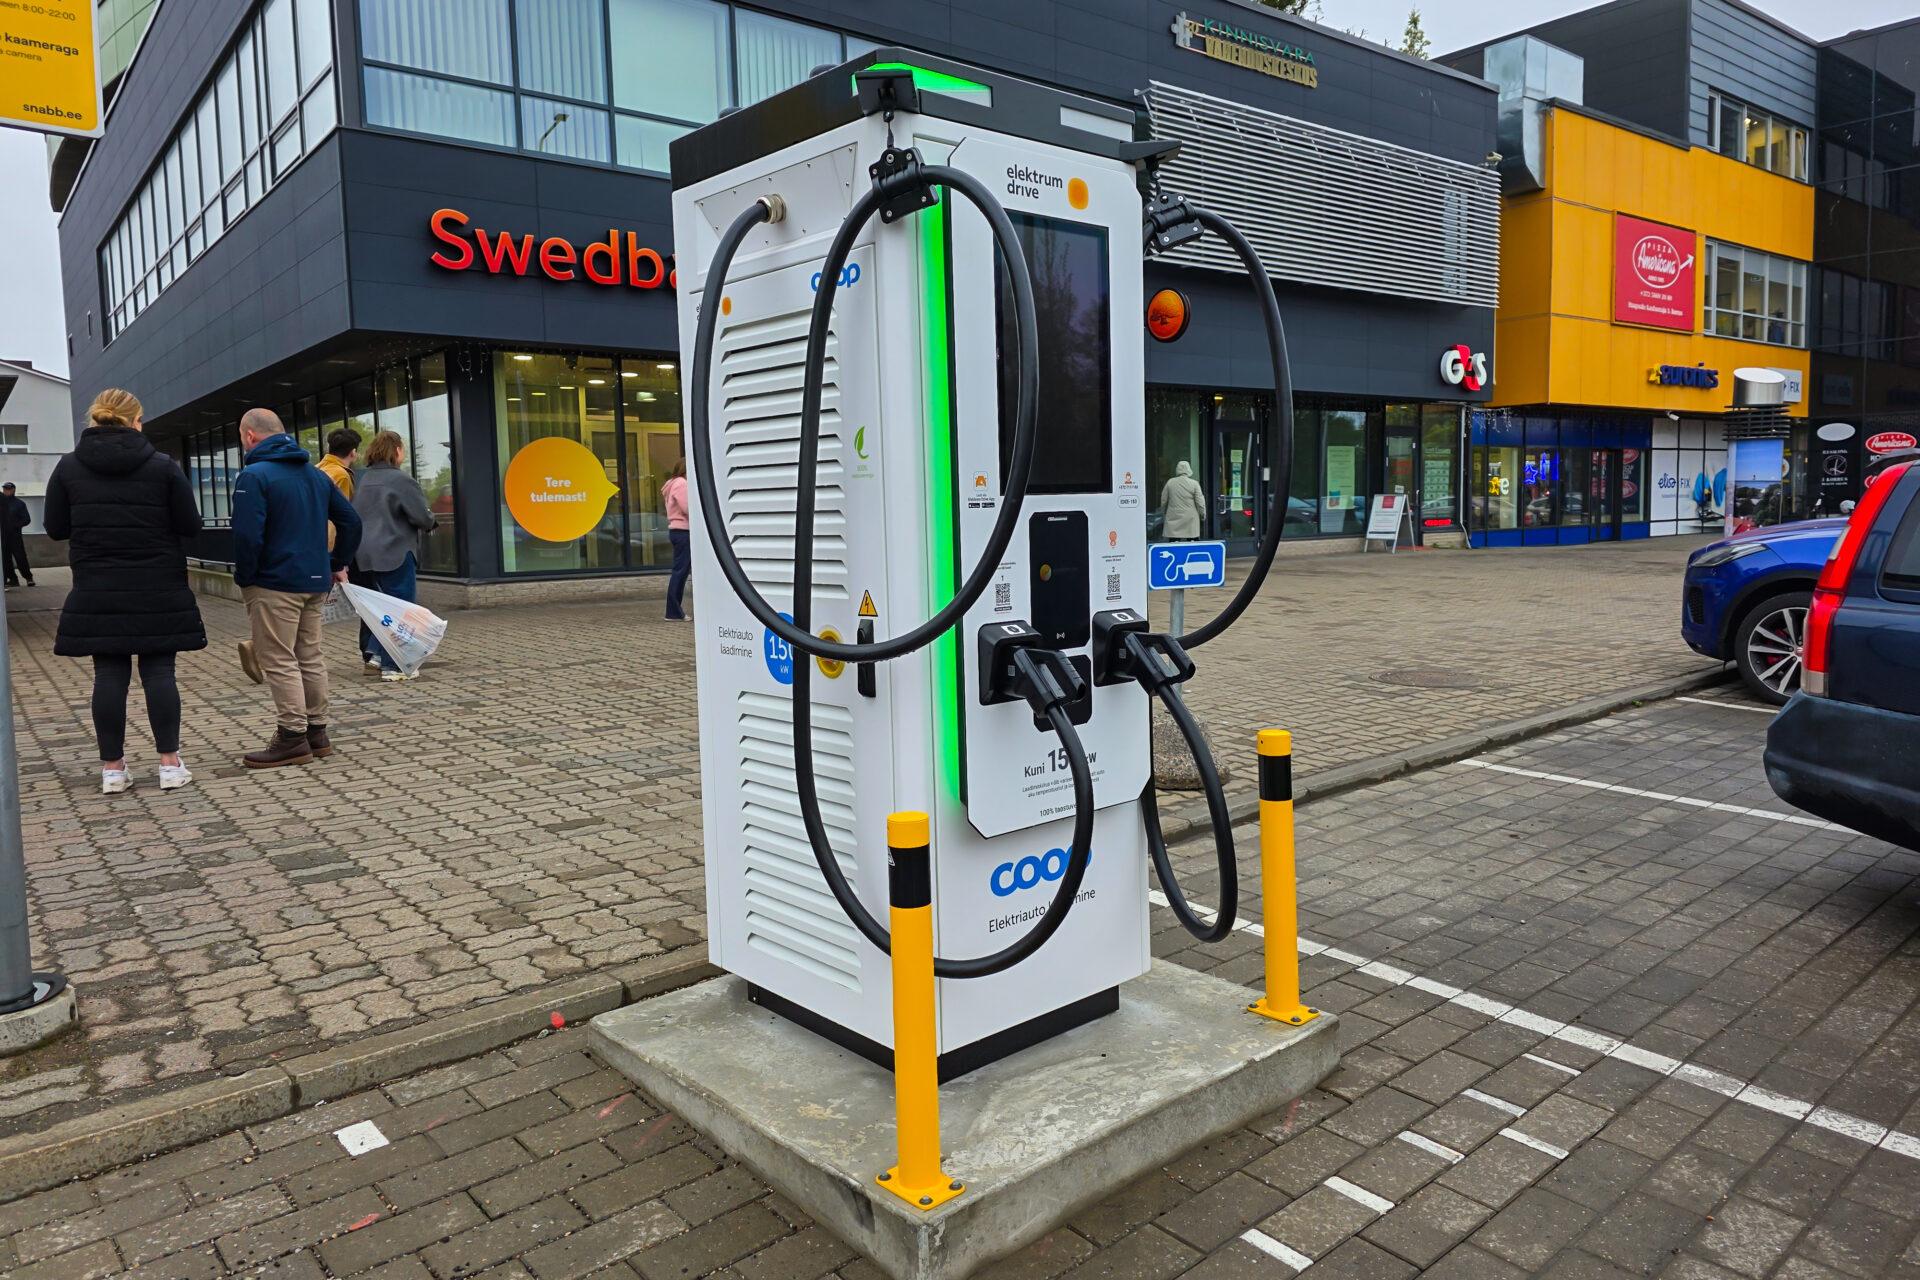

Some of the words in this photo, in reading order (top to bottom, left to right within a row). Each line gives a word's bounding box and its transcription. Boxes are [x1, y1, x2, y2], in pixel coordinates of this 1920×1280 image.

[22, 3, 76, 21] 8:00-22:00
[4, 32, 79, 56] kaameraga
[1204, 18, 1315, 65] KINNISVARA
[5, 49, 42, 62] camera
[23, 104, 82, 120] snabb.ee
[1006, 164, 1063, 188] elektrum
[1007, 179, 1039, 199] drive
[430, 208, 677, 289] Swedb
[810, 262, 861, 291] cop
[1440, 345, 1487, 391] G4S
[1660, 362, 1719, 389] euronics
[1789, 381, 1800, 393] FIX
[1871, 436, 1912, 448] Americana
[545, 477, 571, 488] Tere
[1680, 478, 1690, 488] FIX
[530, 491, 587, 503] tulemast!
[718, 626, 753, 641] Elektriauto
[720, 643, 753, 658] laadimine
[780, 664, 789, 674] kW
[1024, 763, 1045, 777] Kuni
[1048, 748, 1070, 772] 15
[1040, 808, 1054, 817] 100%
[989, 905, 1046, 933] Elektriauto
